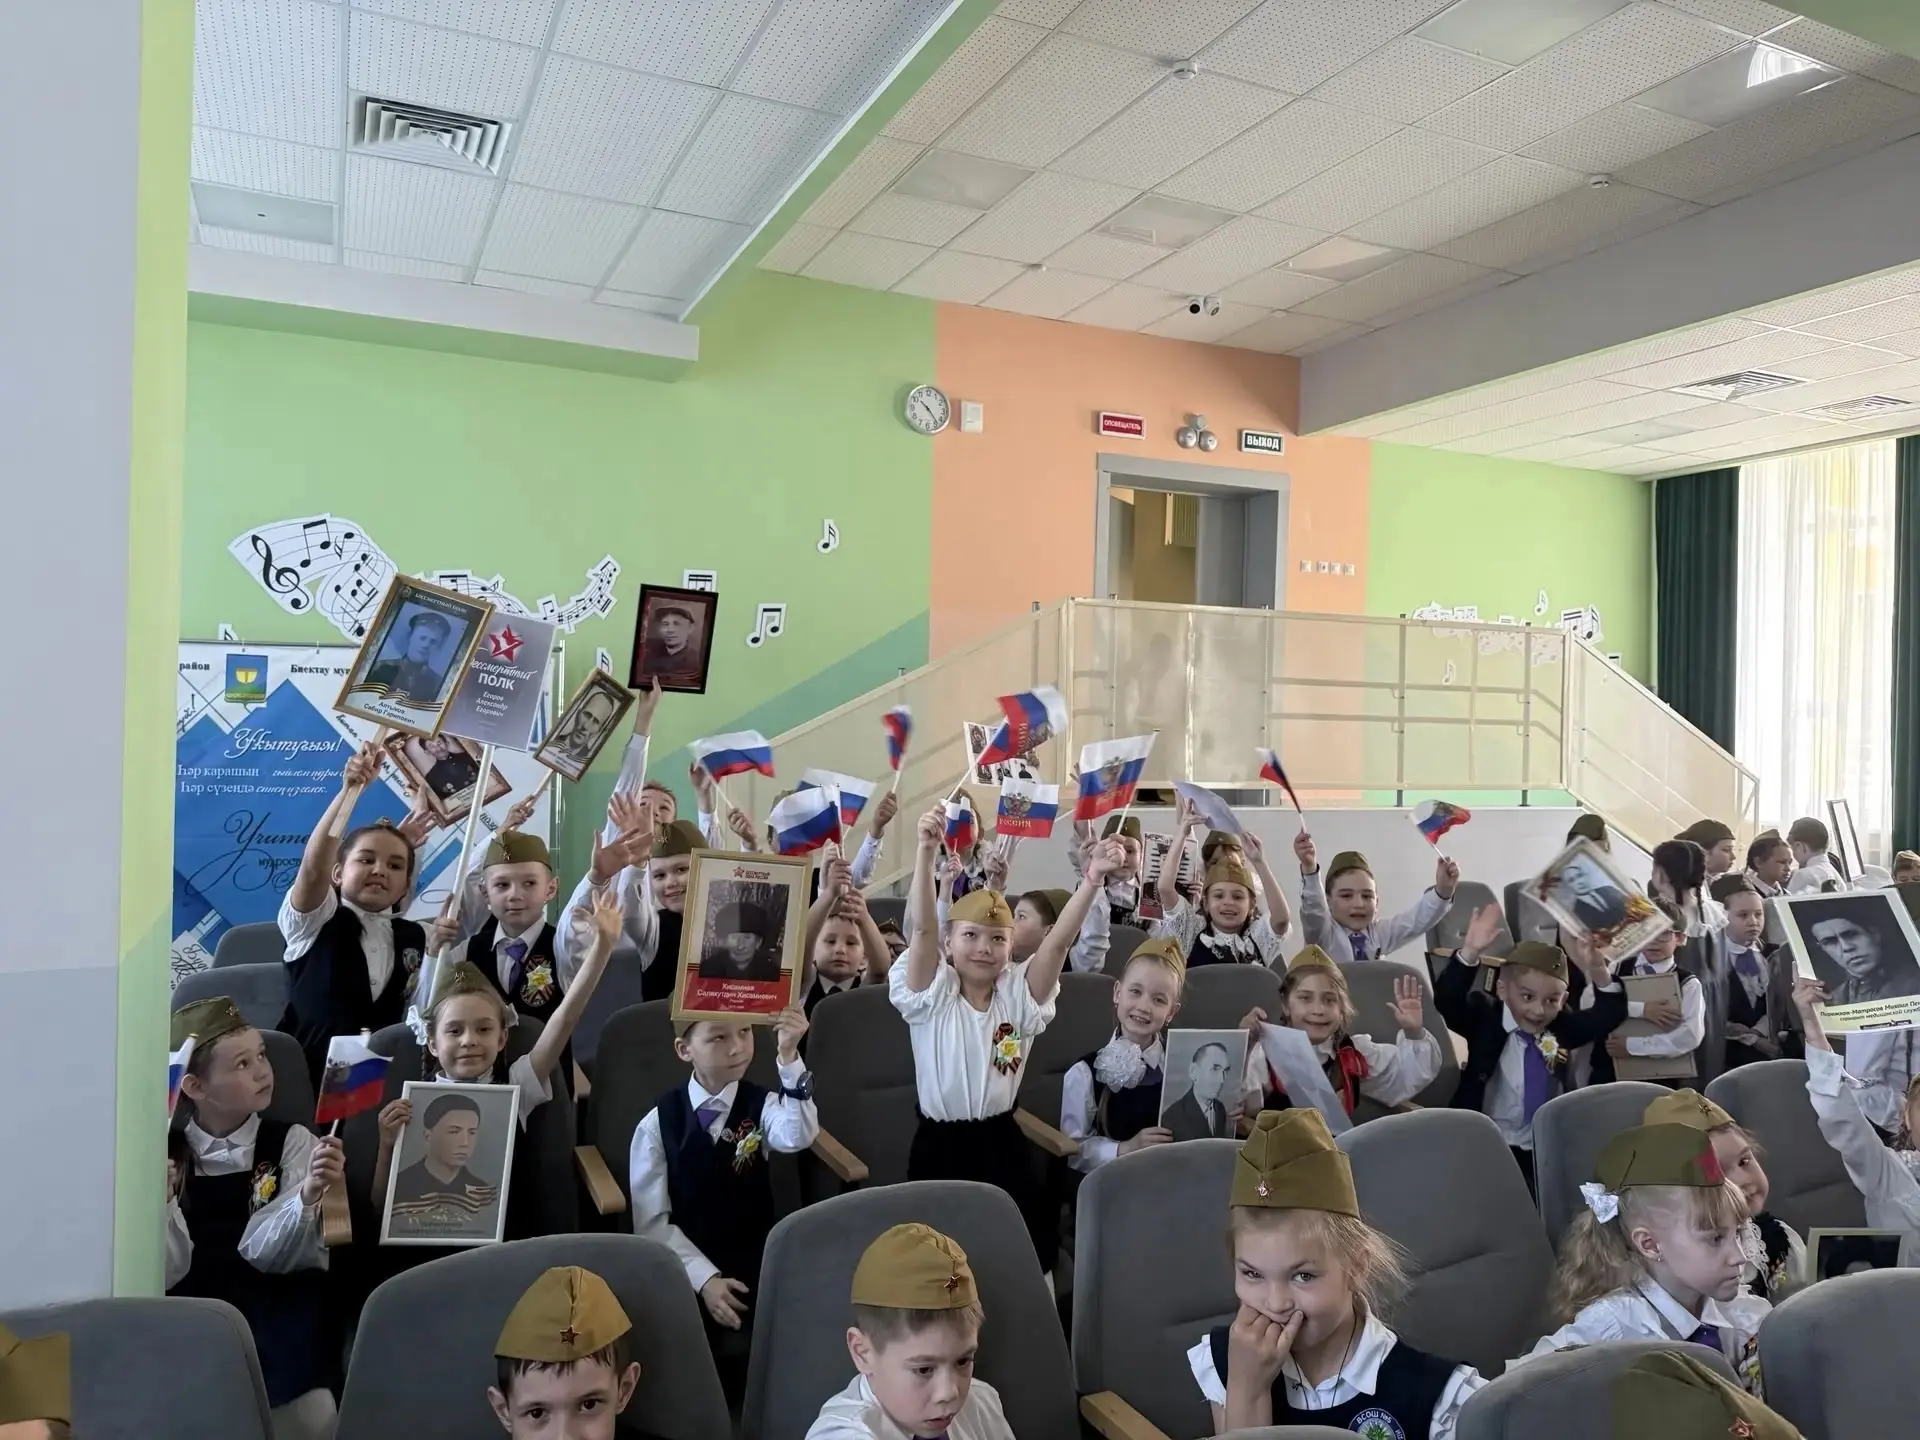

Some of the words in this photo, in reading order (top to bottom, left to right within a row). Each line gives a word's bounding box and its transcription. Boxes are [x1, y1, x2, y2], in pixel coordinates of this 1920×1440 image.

[1104, 418, 1142, 431] ОПОВЕЩАТЕЛЬ
[1246, 435, 1280, 450] ВЫХОД
[179, 662, 211, 672] район
[290, 664, 330, 676] Биектау
[471, 654, 538, 680] ессмертный
[478, 672, 515, 691] ПОЛК
[483, 691, 504, 701] Егоров
[475, 697, 508, 711] Александр
[363, 703, 383, 714] Сабир
[382, 709, 416, 725] Гарипович
[1884, 1002, 1909, 1011] Михаил
[1356, 1410, 1379, 1425] ВСОШ
